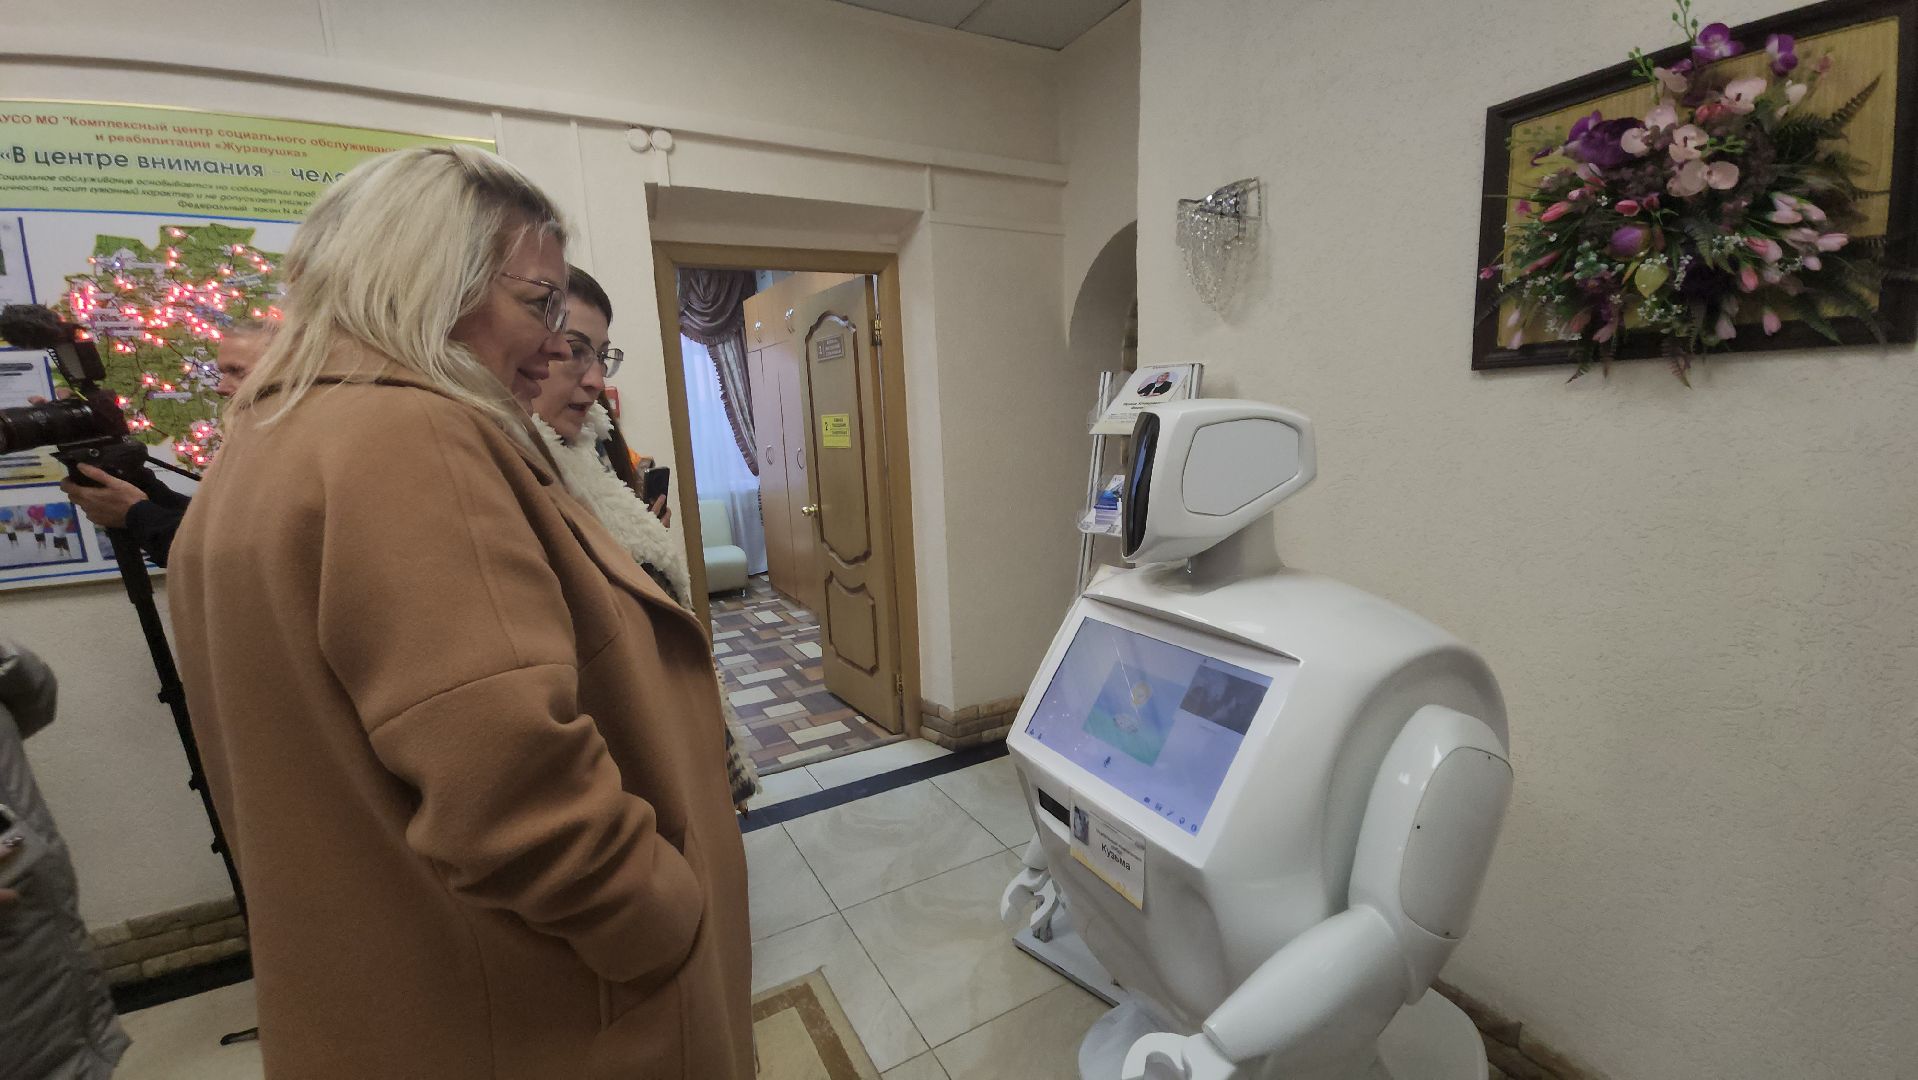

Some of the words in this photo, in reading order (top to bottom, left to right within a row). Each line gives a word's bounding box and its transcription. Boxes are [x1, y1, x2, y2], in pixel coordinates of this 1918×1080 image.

[36, 115, 59, 125] МО
[172, 126, 214, 138] центр
[218, 128, 307, 146] социального
[95, 133, 104, 142] и
[108, 134, 210, 150] реабилитации
[35, 151, 129, 169] центре
[138, 156, 264, 177] внимания
[1101, 842, 1131, 871] Кузьма
